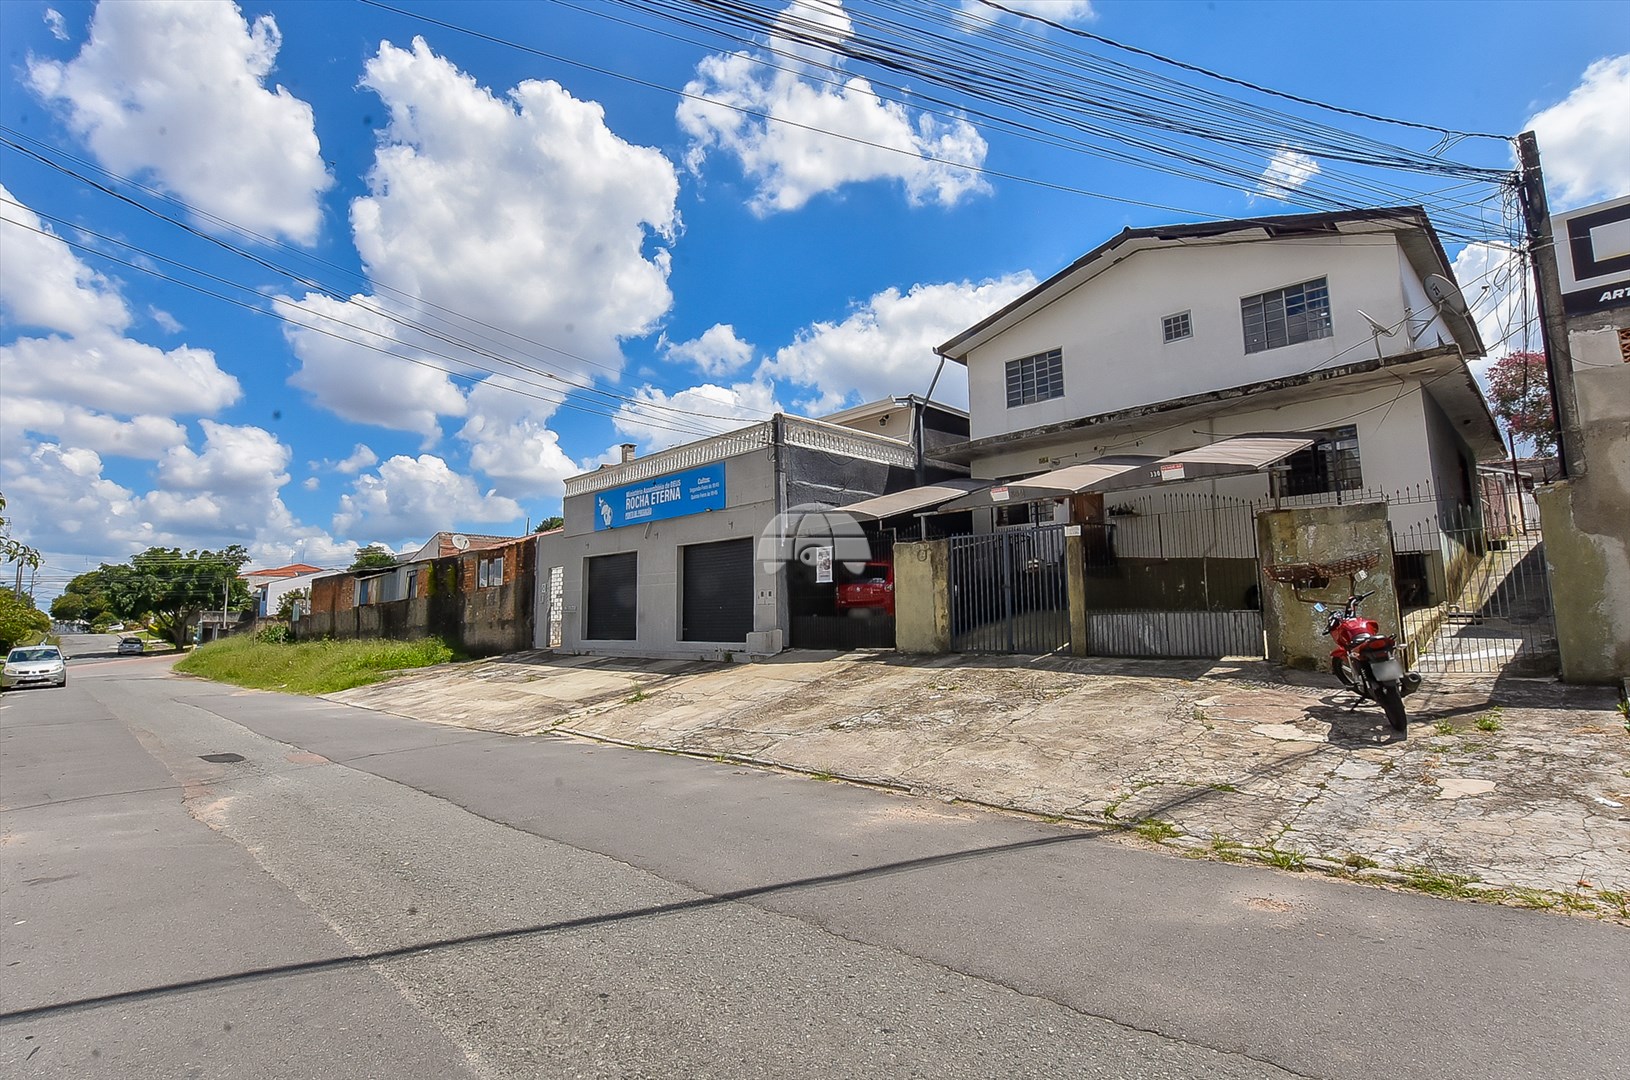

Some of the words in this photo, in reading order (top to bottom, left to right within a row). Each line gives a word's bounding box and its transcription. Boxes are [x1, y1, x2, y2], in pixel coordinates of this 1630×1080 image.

[670, 479, 681, 487] DEUS
[625, 493, 650, 510] ROCHA
[651, 487, 681, 505] ETERNA
